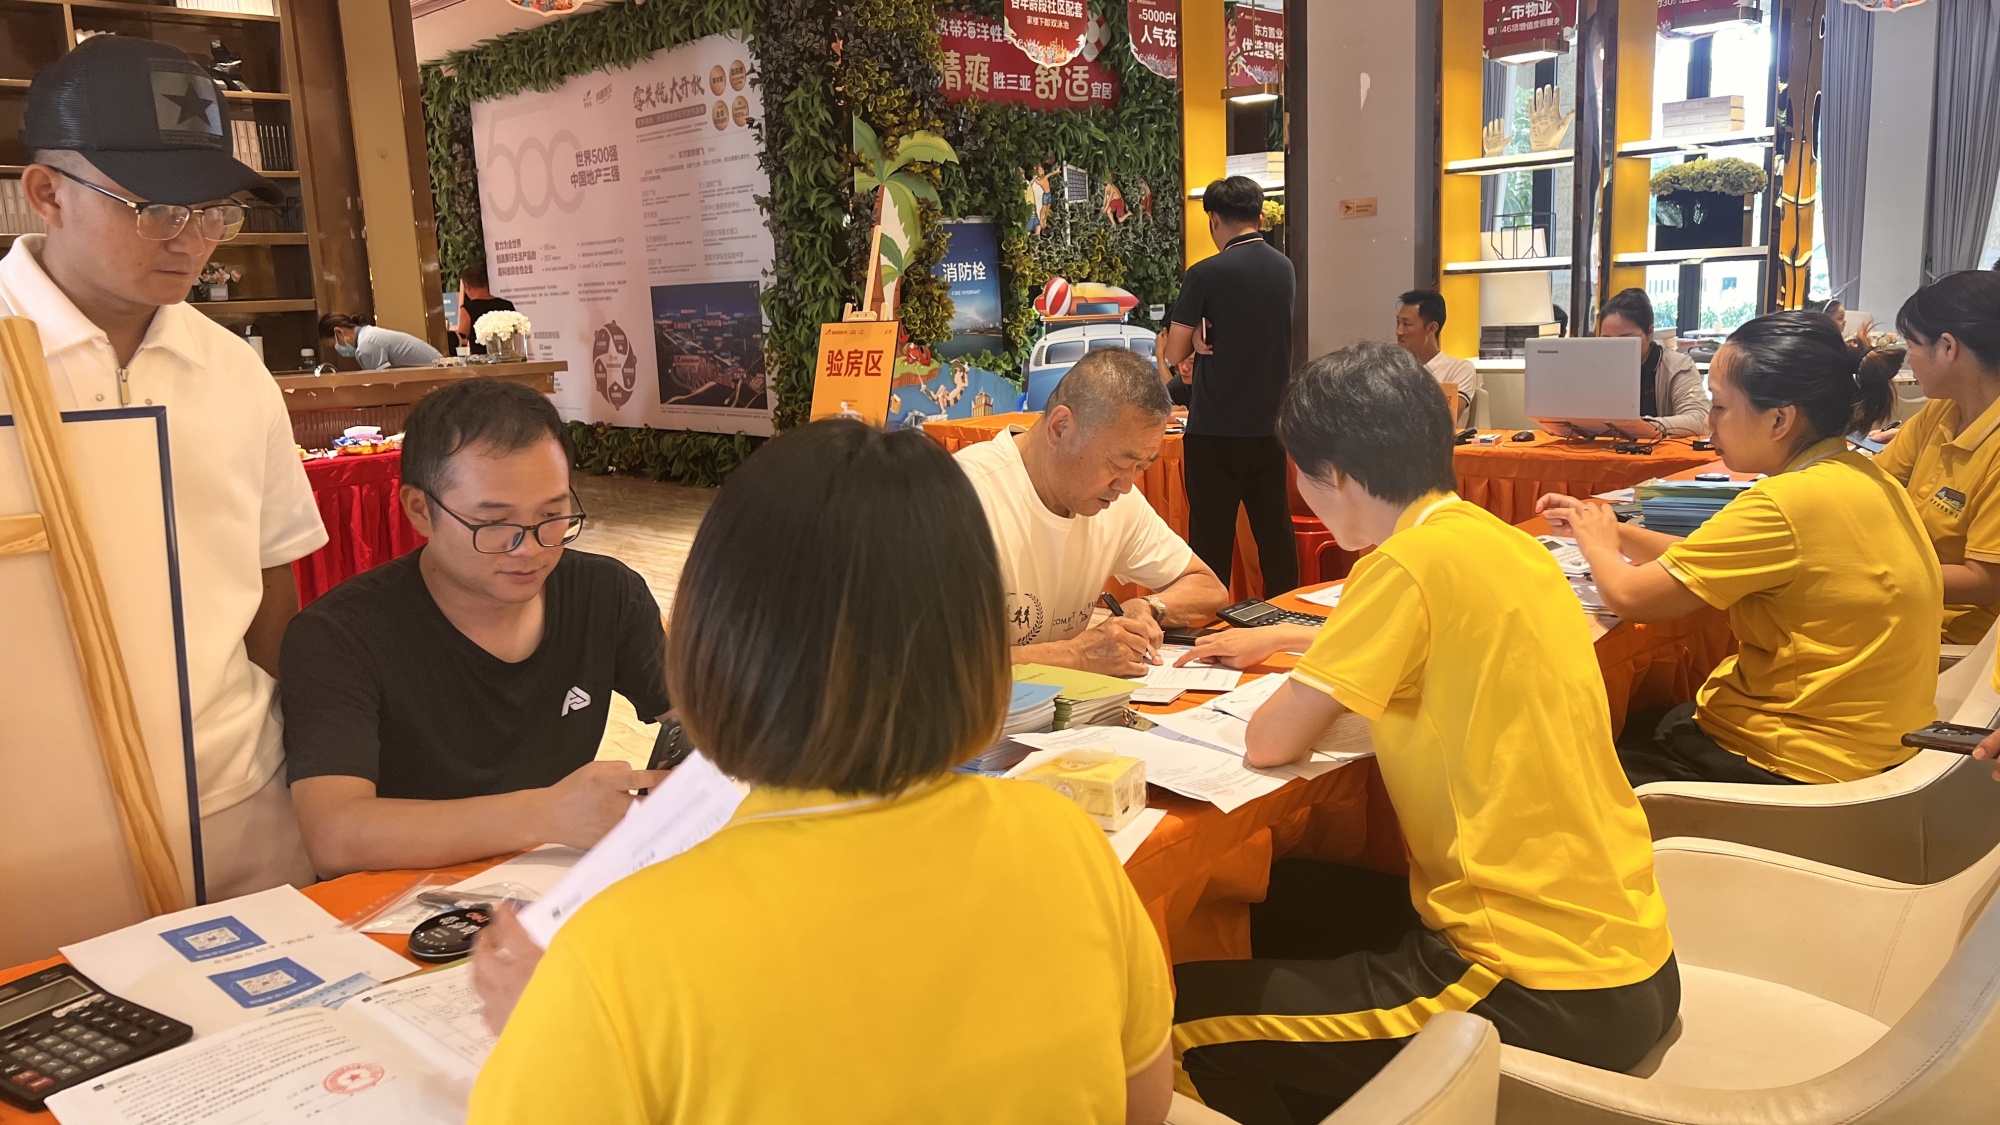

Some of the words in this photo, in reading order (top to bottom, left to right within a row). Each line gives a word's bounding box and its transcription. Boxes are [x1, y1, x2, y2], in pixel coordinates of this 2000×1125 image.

[940, 17, 1013, 45] 热带海洋性
[575, 144, 619, 168] 世界500强
[570, 165, 621, 189] 中国地产三强
[942, 261, 987, 283] 消防栓
[825, 348, 884, 378] 验房区
